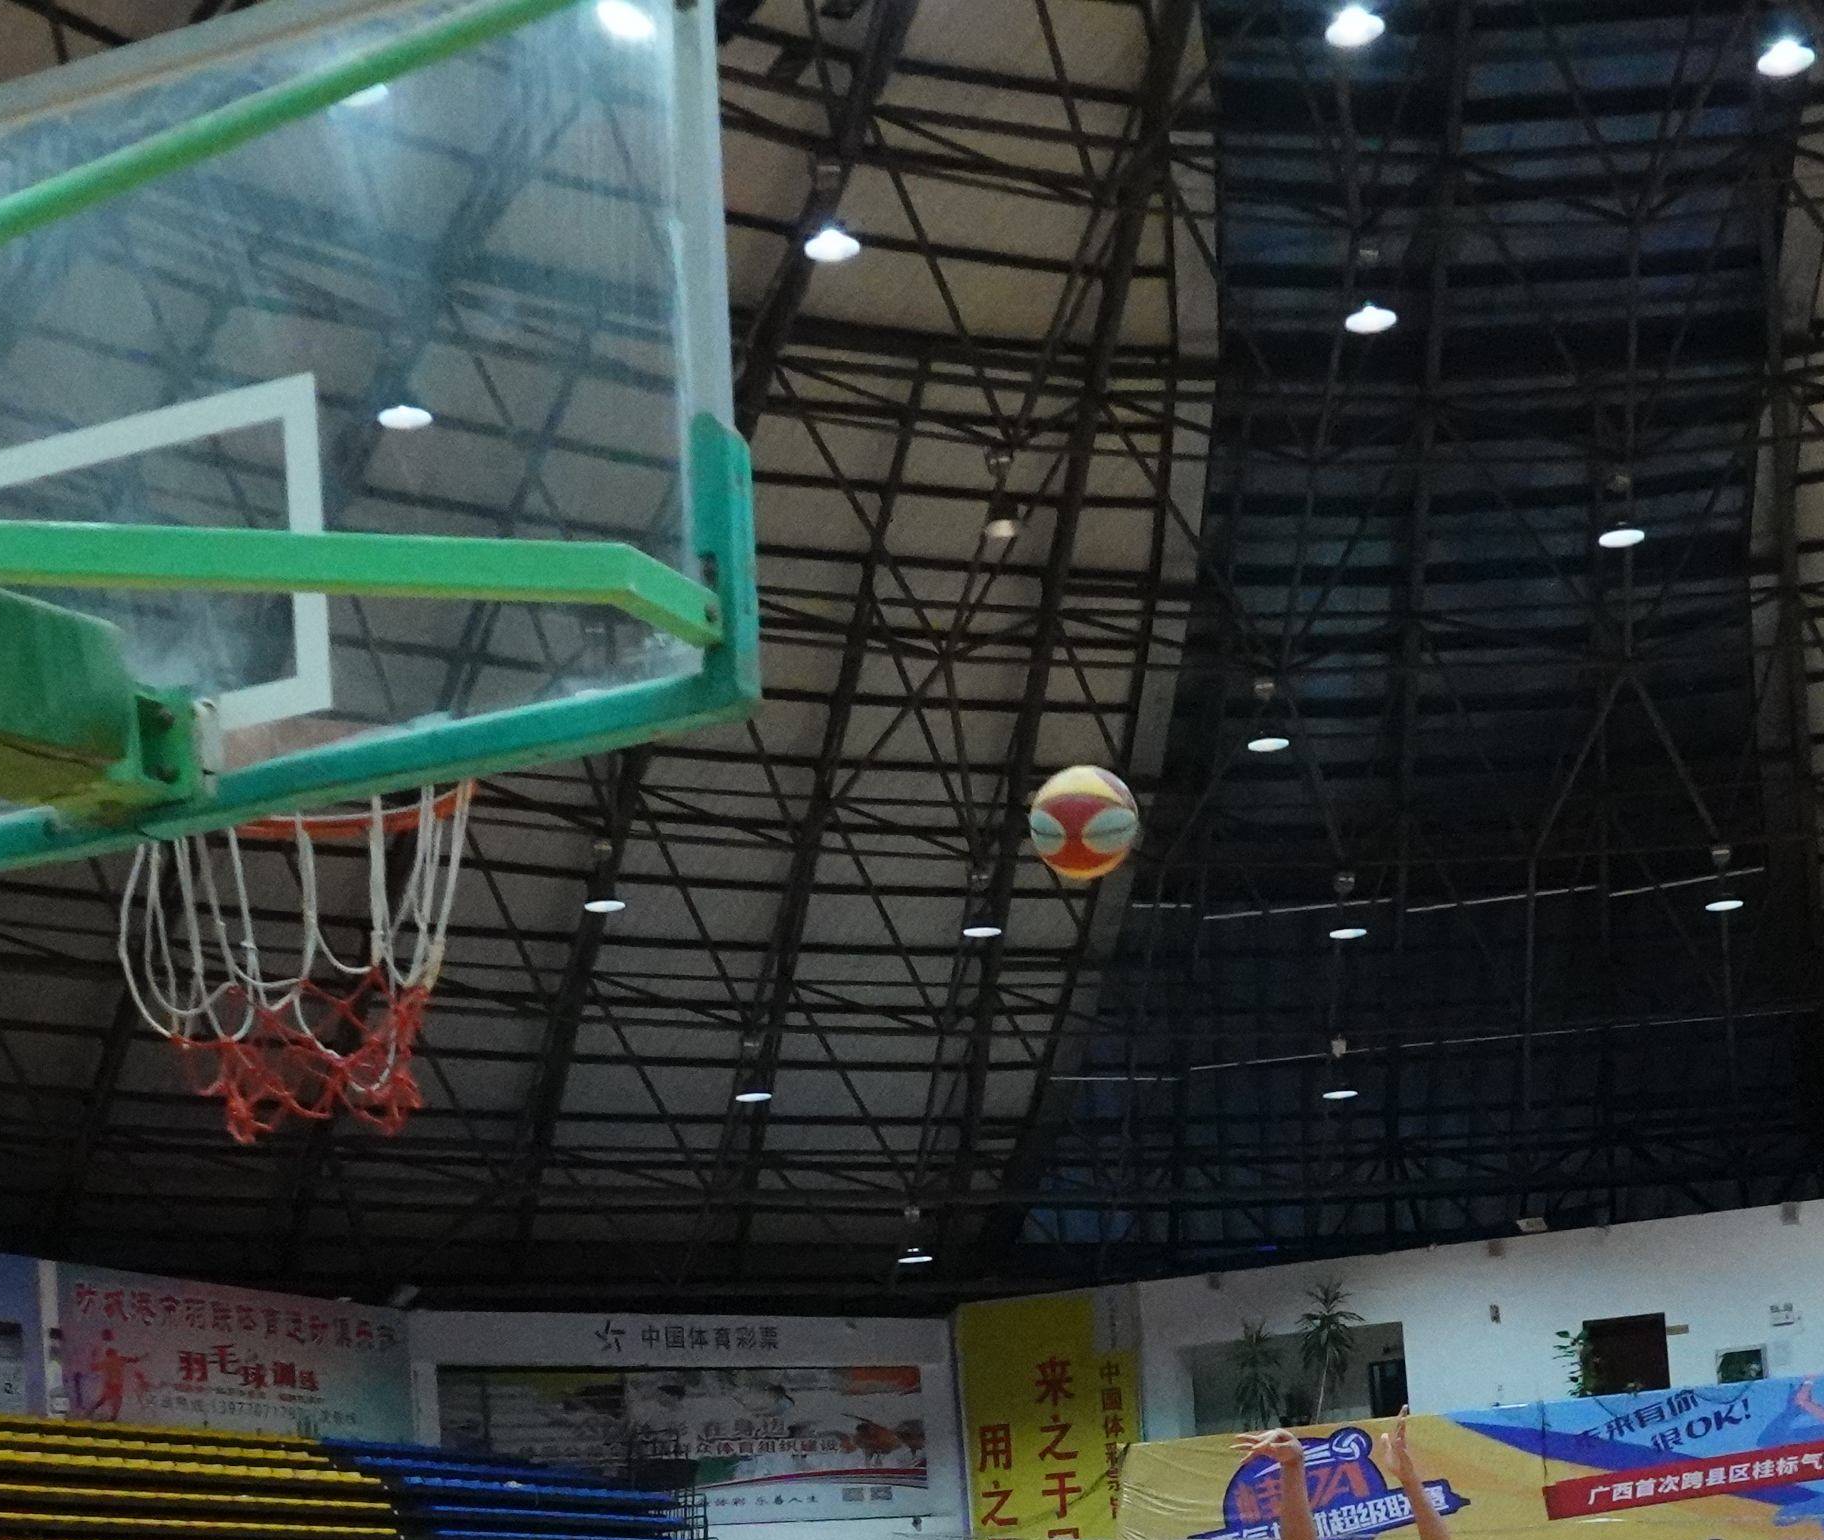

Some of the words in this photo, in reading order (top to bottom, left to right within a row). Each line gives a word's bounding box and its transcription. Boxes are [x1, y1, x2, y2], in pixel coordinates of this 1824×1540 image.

[641, 1324, 779, 1351] 中国体育彩票
